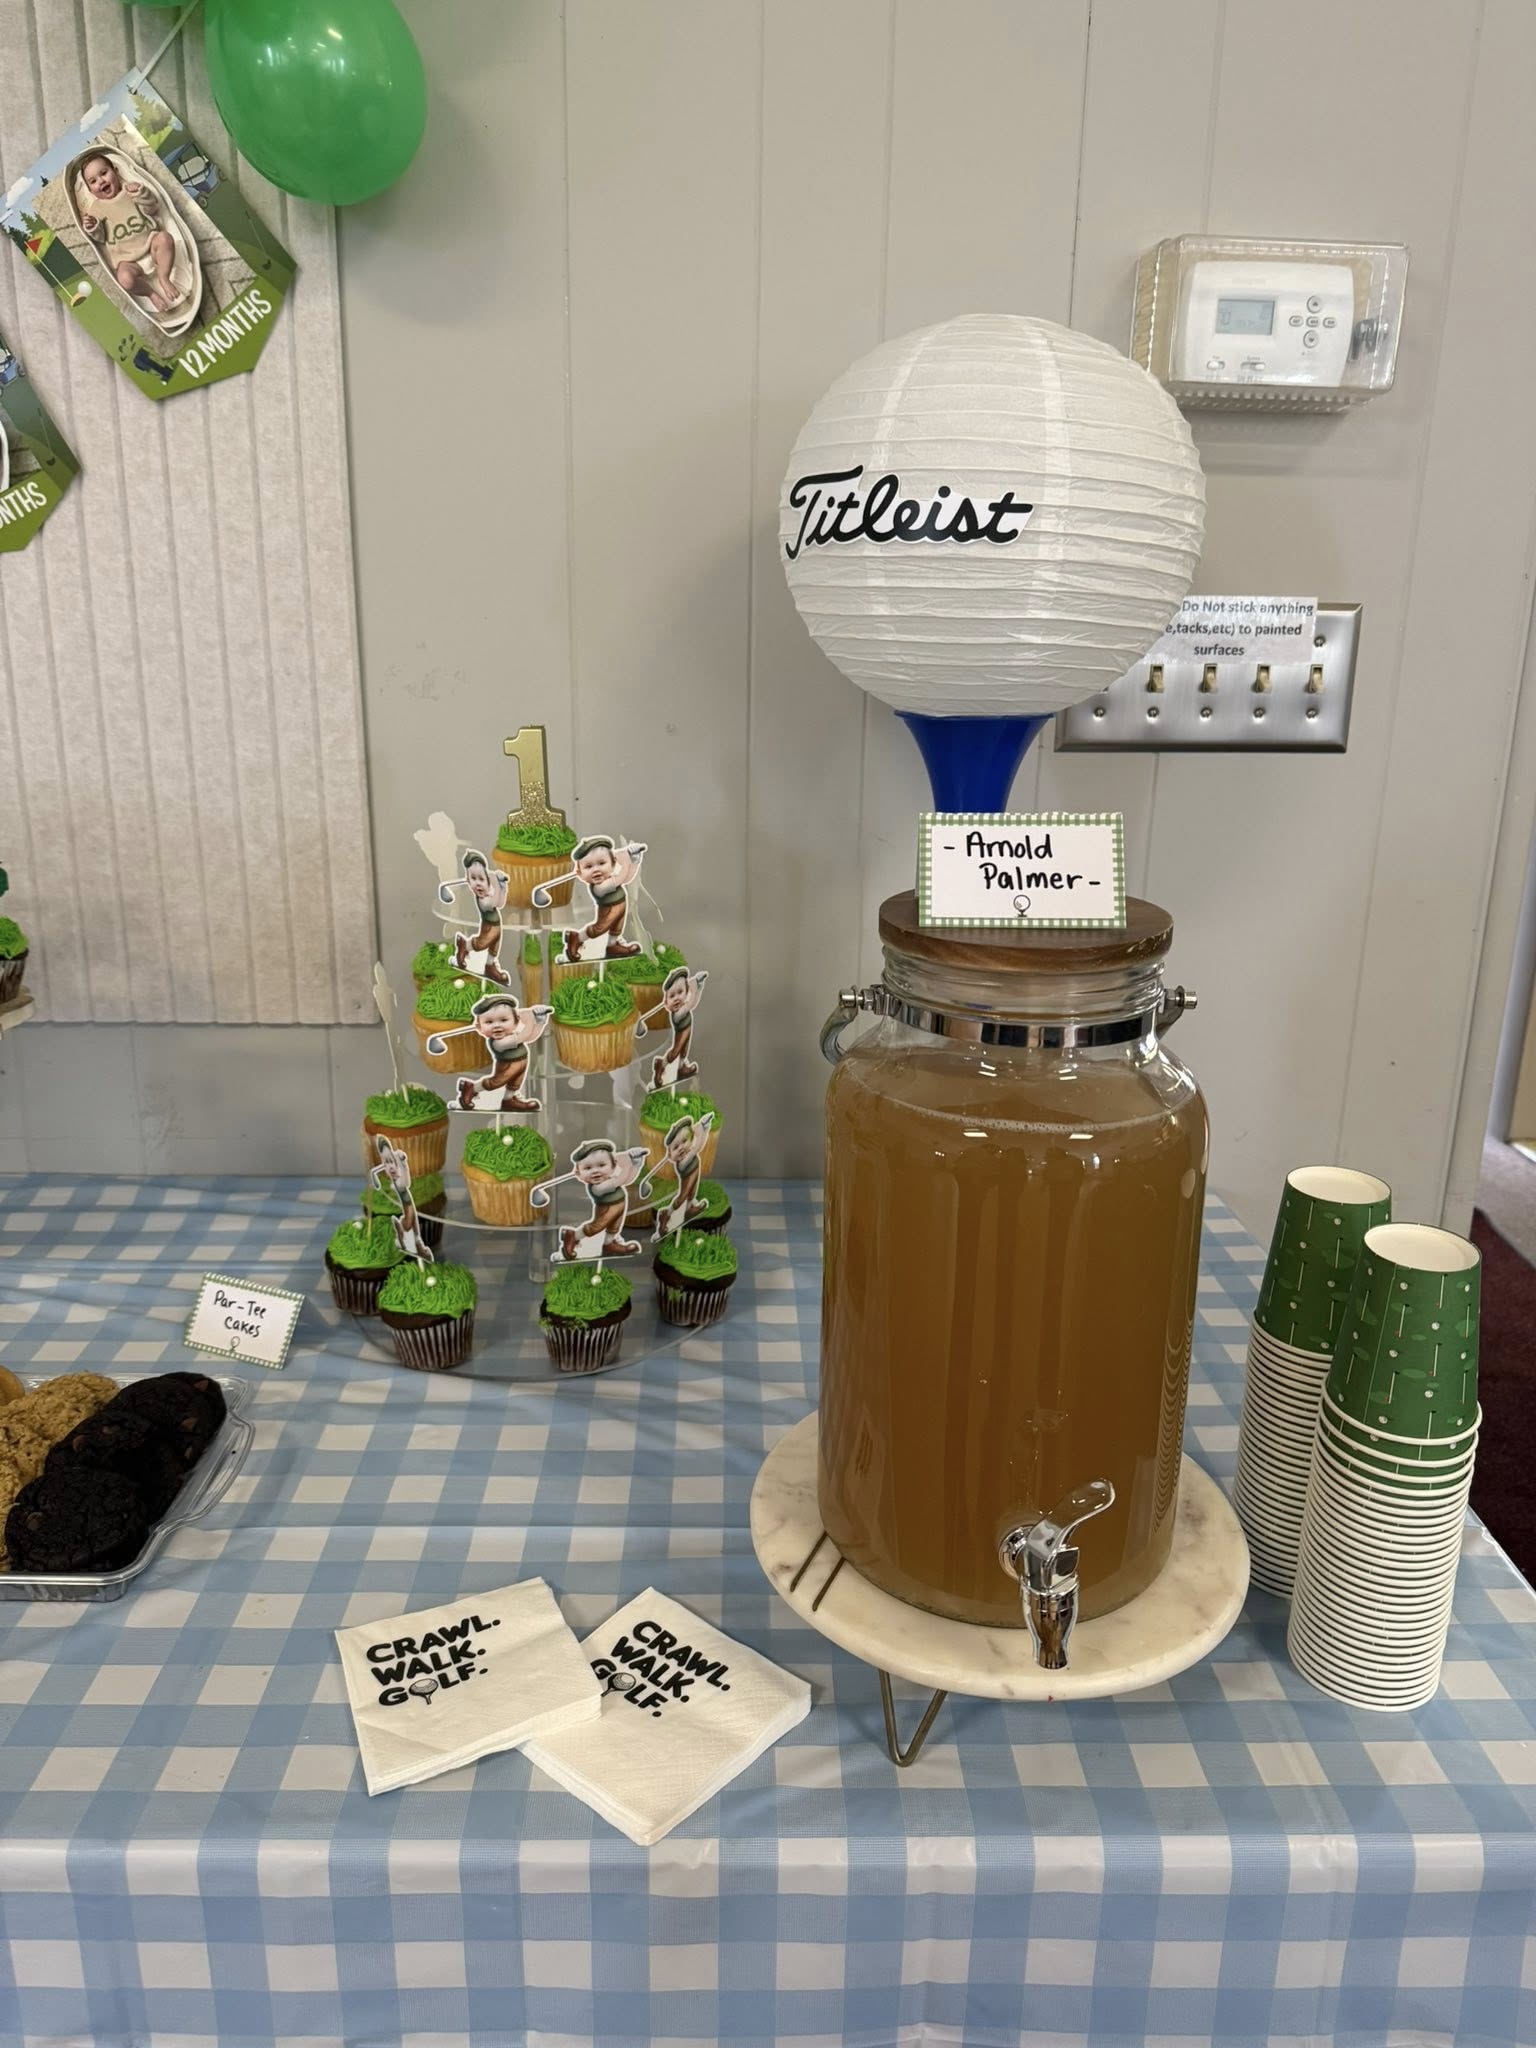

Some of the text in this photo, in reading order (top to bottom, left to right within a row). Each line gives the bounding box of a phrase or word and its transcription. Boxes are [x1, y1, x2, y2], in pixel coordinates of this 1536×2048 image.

[178, 289, 272, 378] 12 MONTHS
[0, 482, 47, 529] NTHS
[785, 464, 1034, 560] Titleist
[1182, 600, 1314, 617] Do Not stick anything
[1238, 624, 1252, 635] to
[1255, 624, 1302, 637] painted
[1194, 643, 1245, 656] surfaces
[503, 725, 567, 829] 1
[966, 831, 1053, 859] Arnold
[213, 1290, 267, 1319] Par-Tee
[224, 1316, 261, 1338] Cakes
[366, 1615, 501, 1663] CRAWL.
[632, 1620, 730, 1691] CRAWL.
[371, 1640, 486, 1686] WALK.
[611, 1636, 695, 1703] WALK.
